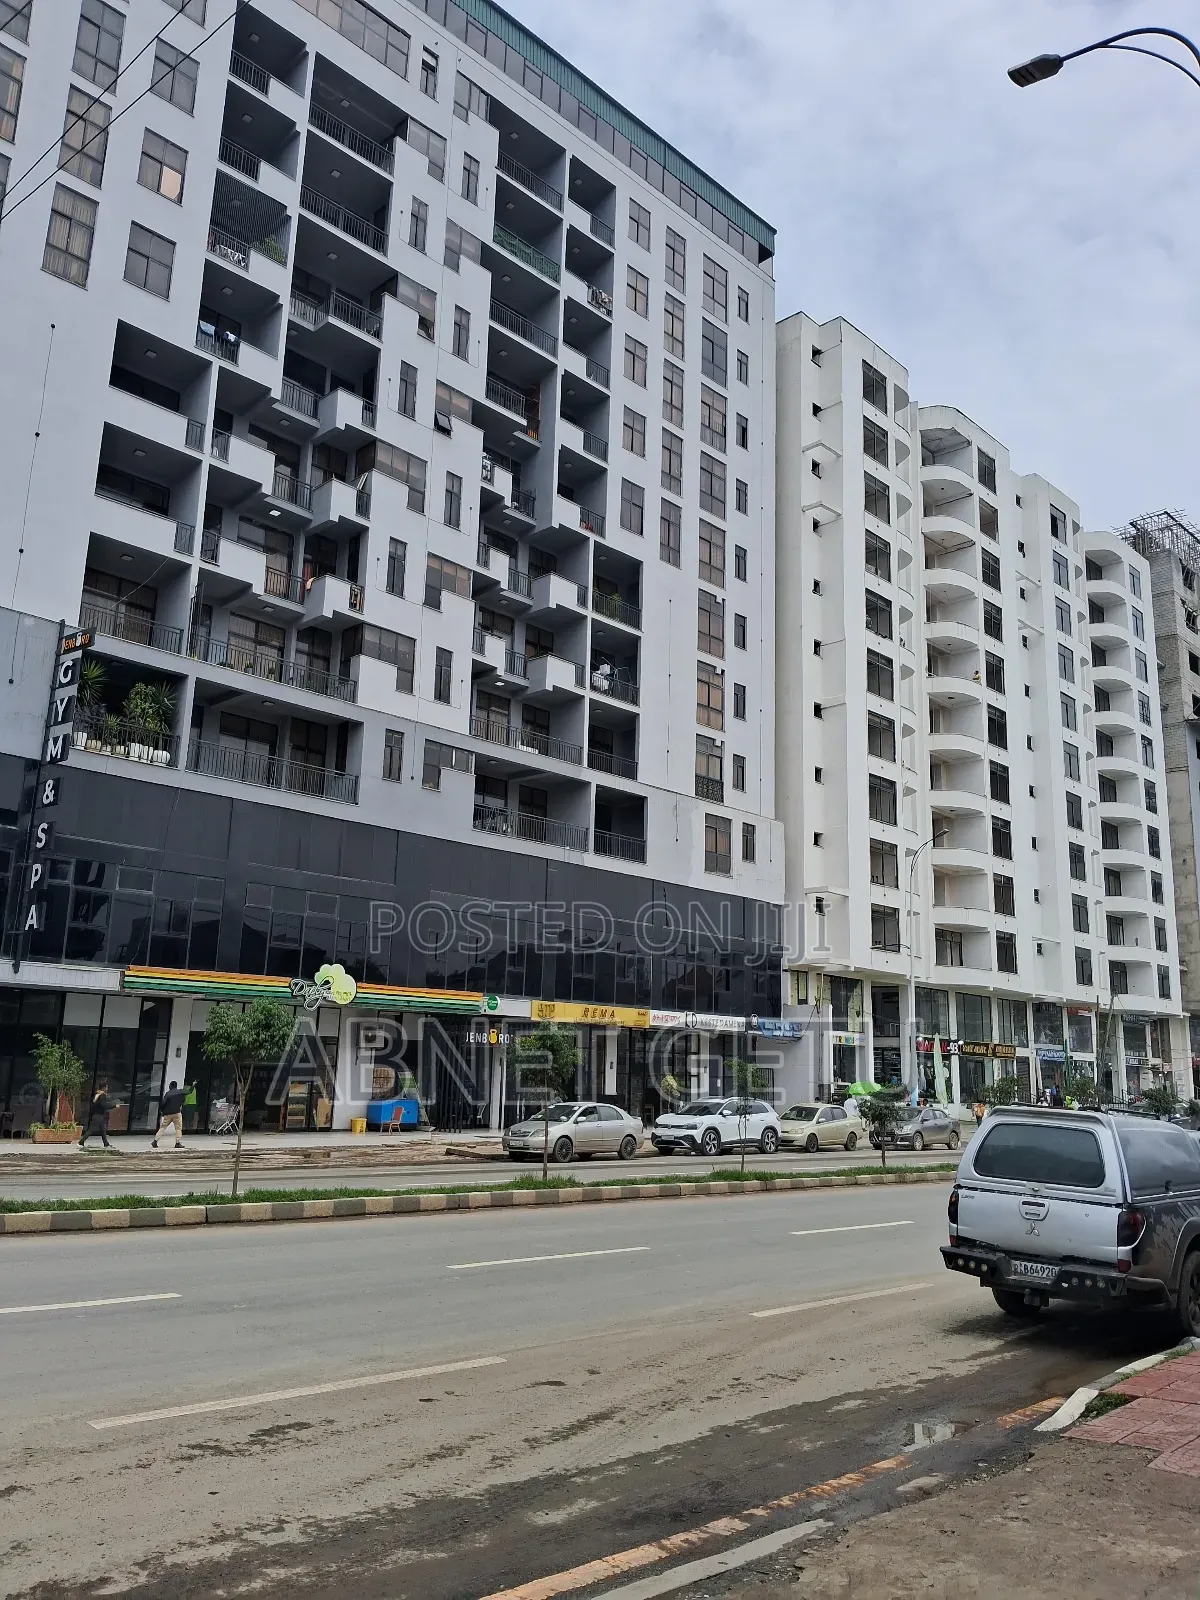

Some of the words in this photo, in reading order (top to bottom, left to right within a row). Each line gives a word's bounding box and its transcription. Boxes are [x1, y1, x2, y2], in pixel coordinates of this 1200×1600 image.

[46, 660, 73, 762] GYM
[42, 779, 56, 805] &
[25, 822, 49, 931] SPA
[581, 1007, 616, 1019] REMA
